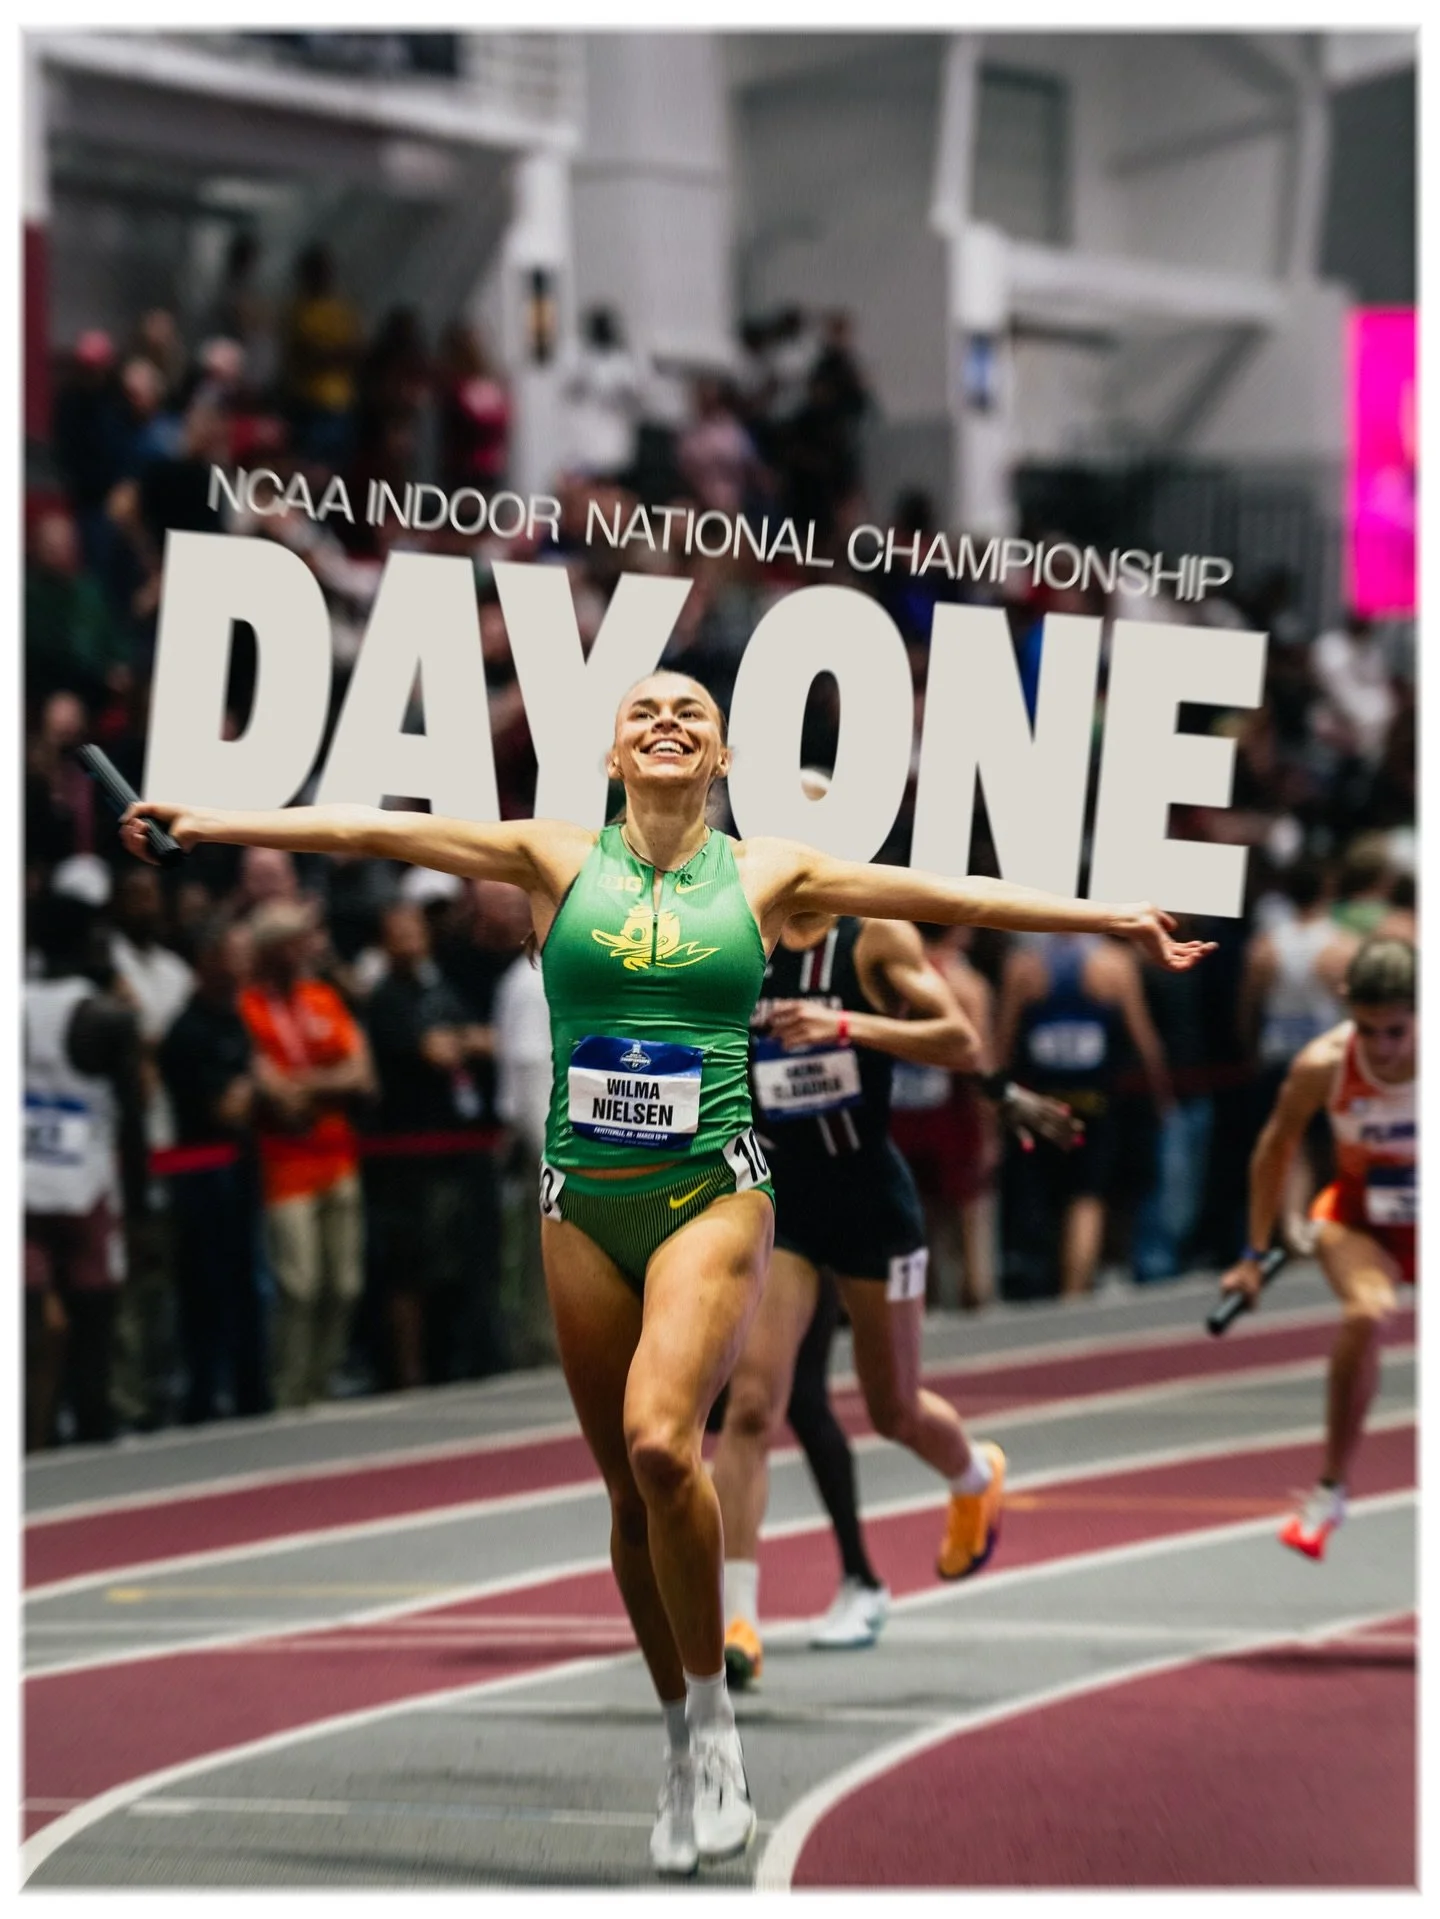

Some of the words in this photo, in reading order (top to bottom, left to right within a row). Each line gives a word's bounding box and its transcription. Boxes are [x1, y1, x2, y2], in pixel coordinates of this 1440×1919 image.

[606, 1078, 661, 1100] WILMA
[592, 1097, 674, 1127] NIELSEN
[733, 1127, 767, 1184] 10
